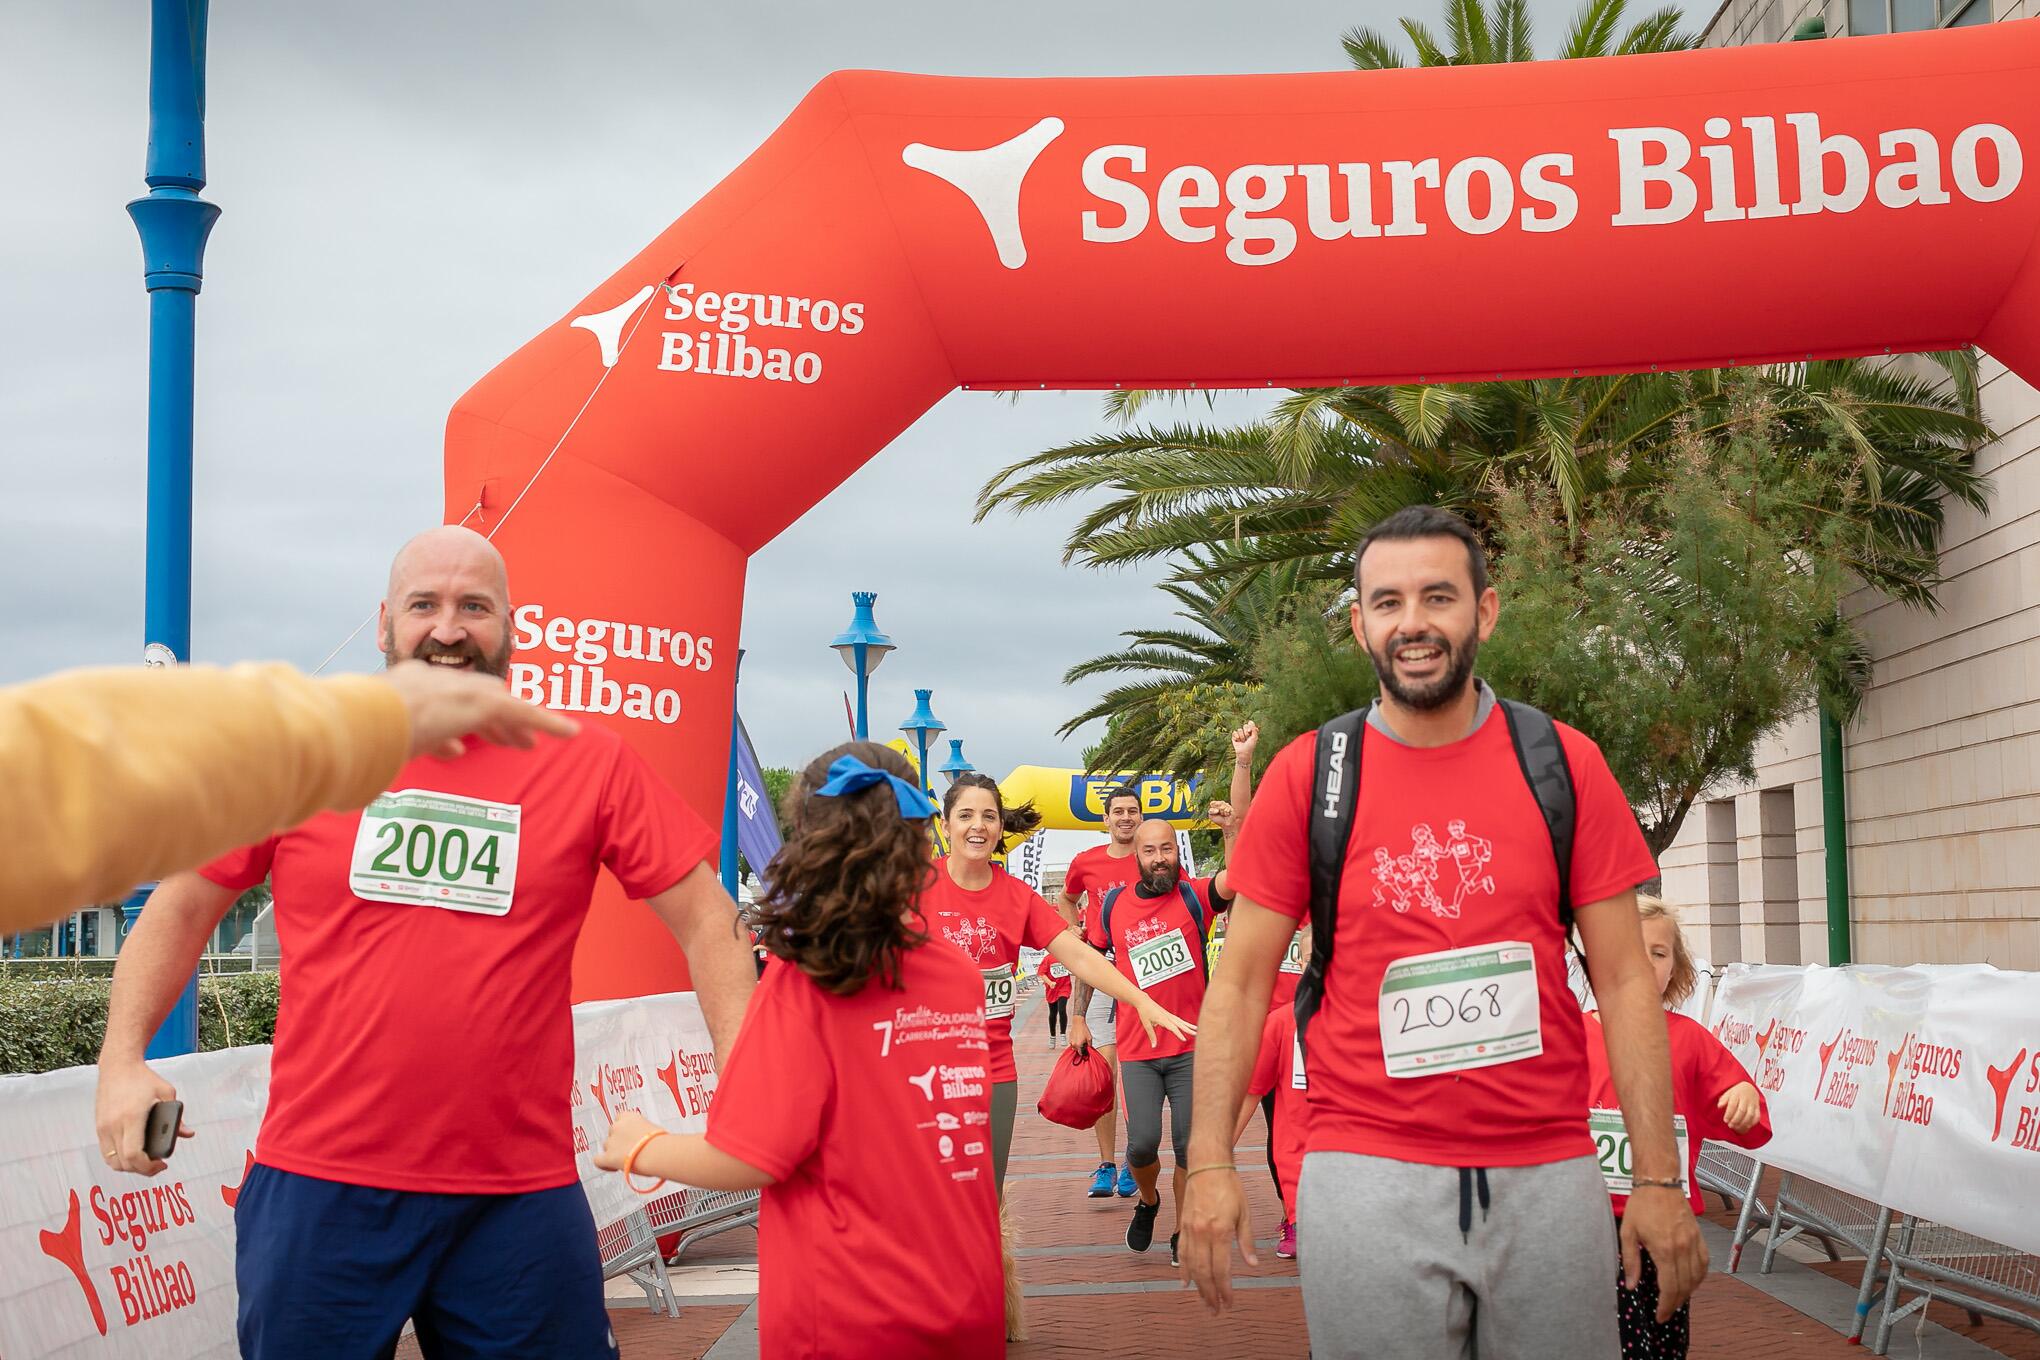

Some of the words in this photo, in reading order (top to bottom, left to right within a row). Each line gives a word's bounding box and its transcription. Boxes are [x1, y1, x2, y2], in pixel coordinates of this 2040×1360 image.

[1081, 144, 1579, 266] Seguros
[1608, 112, 2023, 227] Bilbao
[664, 283, 865, 335] Seguros
[657, 331, 823, 384] Bilbao
[513, 604, 713, 672] Seguros
[510, 662, 681, 724] Bilbao
[1323, 732, 1348, 819] HEAD
[371, 821, 500, 885] 2004
[1138, 943, 1185, 977] 2003
[985, 980, 1012, 1004] 49
[1394, 983, 1501, 1034] 2068
[938, 1064, 986, 1083] Seguros
[1838, 1029, 1878, 1071] Seguros
[604, 1063, 644, 1100] Seguros
[942, 1081, 984, 1100] Bilbao
[1824, 1071, 1859, 1110] Bilbao
[1892, 1081, 1934, 1126] Bilbao
[89, 1182, 195, 1252] Seguros
[110, 1254, 196, 1327] Bilbao
